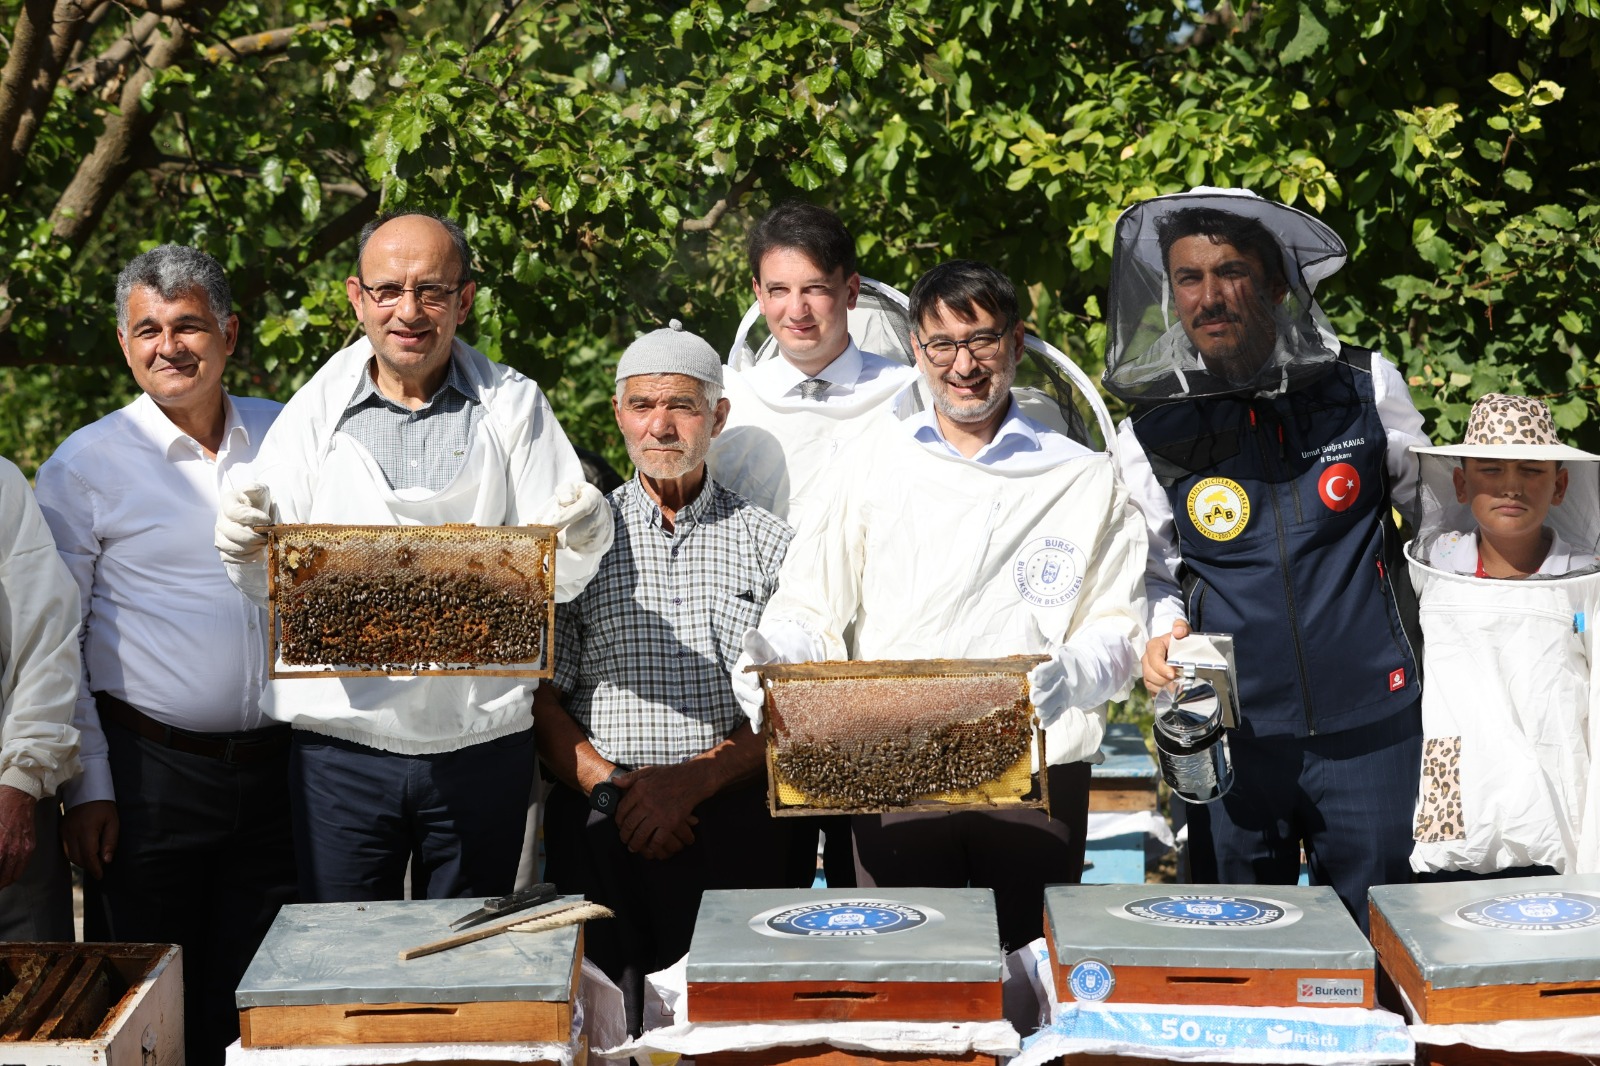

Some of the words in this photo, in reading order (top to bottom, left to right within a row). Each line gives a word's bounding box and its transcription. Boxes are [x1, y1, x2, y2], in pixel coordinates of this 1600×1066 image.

[1302, 448, 1320, 459] Umut
[1204, 506, 1234, 524] TAB
[1045, 539, 1075, 555] BURSA
[1044, 575, 1084, 605] BELEDİYESİ
[1494, 892, 1564, 902] BURSA
[1315, 986, 1358, 997] Burkent
[1160, 1018, 1202, 1042] 50
[1205, 1029, 1228, 1046] kg
